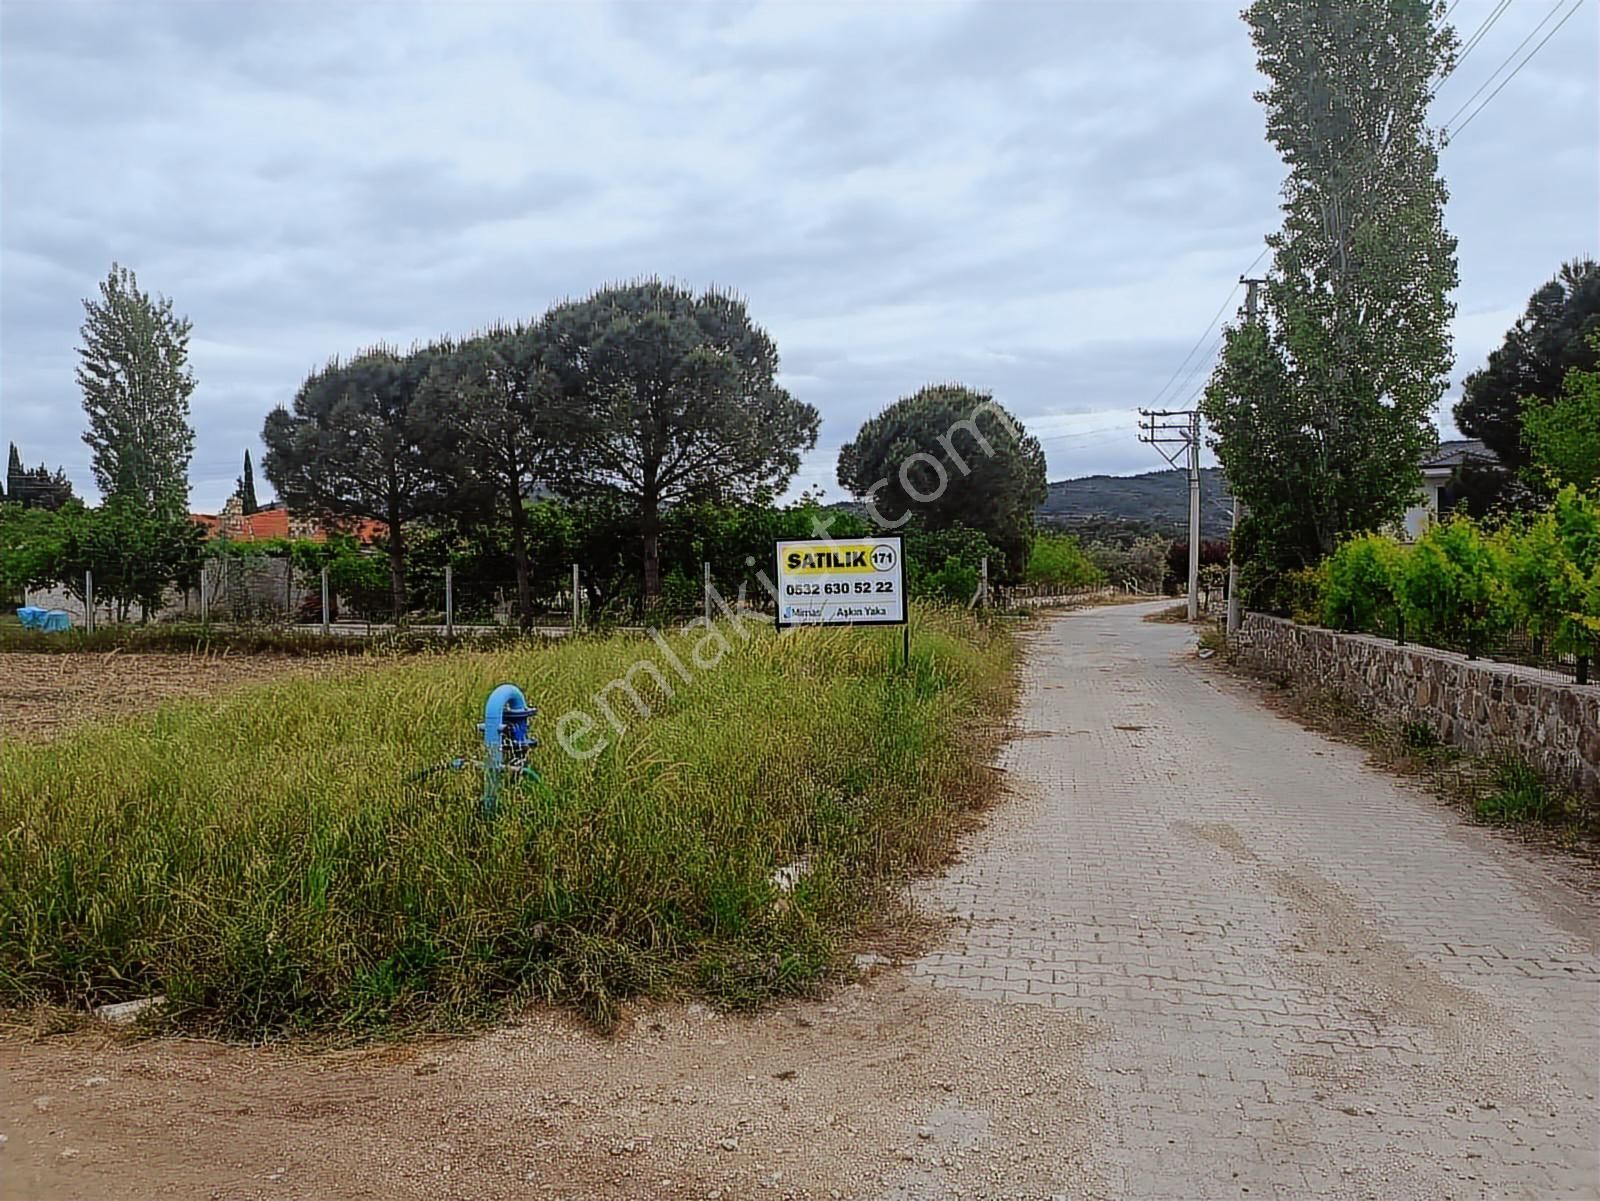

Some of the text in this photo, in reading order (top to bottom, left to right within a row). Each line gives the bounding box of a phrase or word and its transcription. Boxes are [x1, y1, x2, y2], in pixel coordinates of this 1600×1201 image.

[787, 551, 867, 569] SATILIK
[872, 552, 892, 564] 171
[786, 581, 893, 595] 0532 630 52 22
